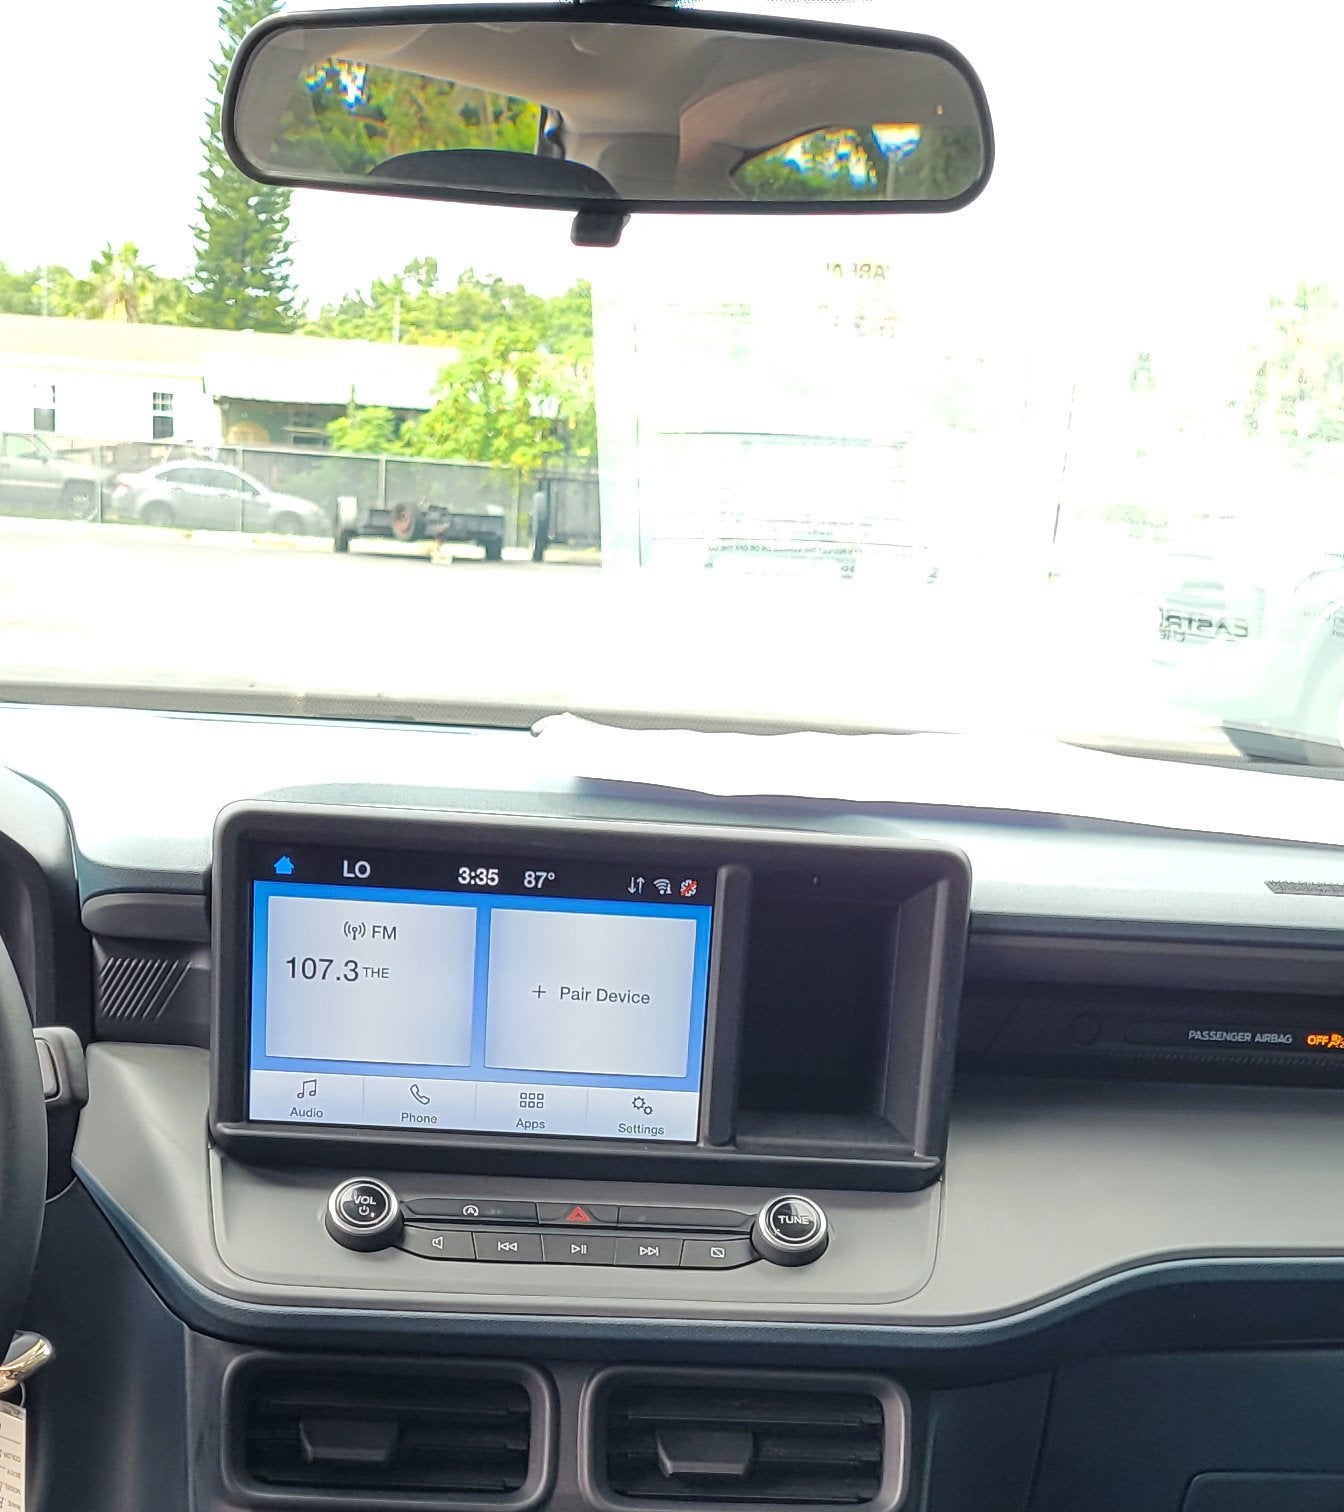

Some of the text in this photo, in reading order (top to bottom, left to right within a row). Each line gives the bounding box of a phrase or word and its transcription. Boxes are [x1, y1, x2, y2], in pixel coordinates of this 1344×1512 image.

[342, 859, 371, 879] LO
[457, 867, 499, 886] 3:35
[523, 871, 556, 889] 87°
[371, 925, 397, 940] FM
[285, 956, 390, 982] 107.3 THE
[559, 986, 651, 1005] Pair Device
[1188, 1030, 1329, 1046] PASSENGER AIRBAG OFF
[290, 1106, 324, 1119] Audio
[401, 1112, 437, 1125] Phone
[516, 1118, 546, 1131] Apps
[618, 1122, 665, 1136] Settings
[354, 1195, 376, 1206] VOL
[777, 1214, 810, 1225] TUNE
